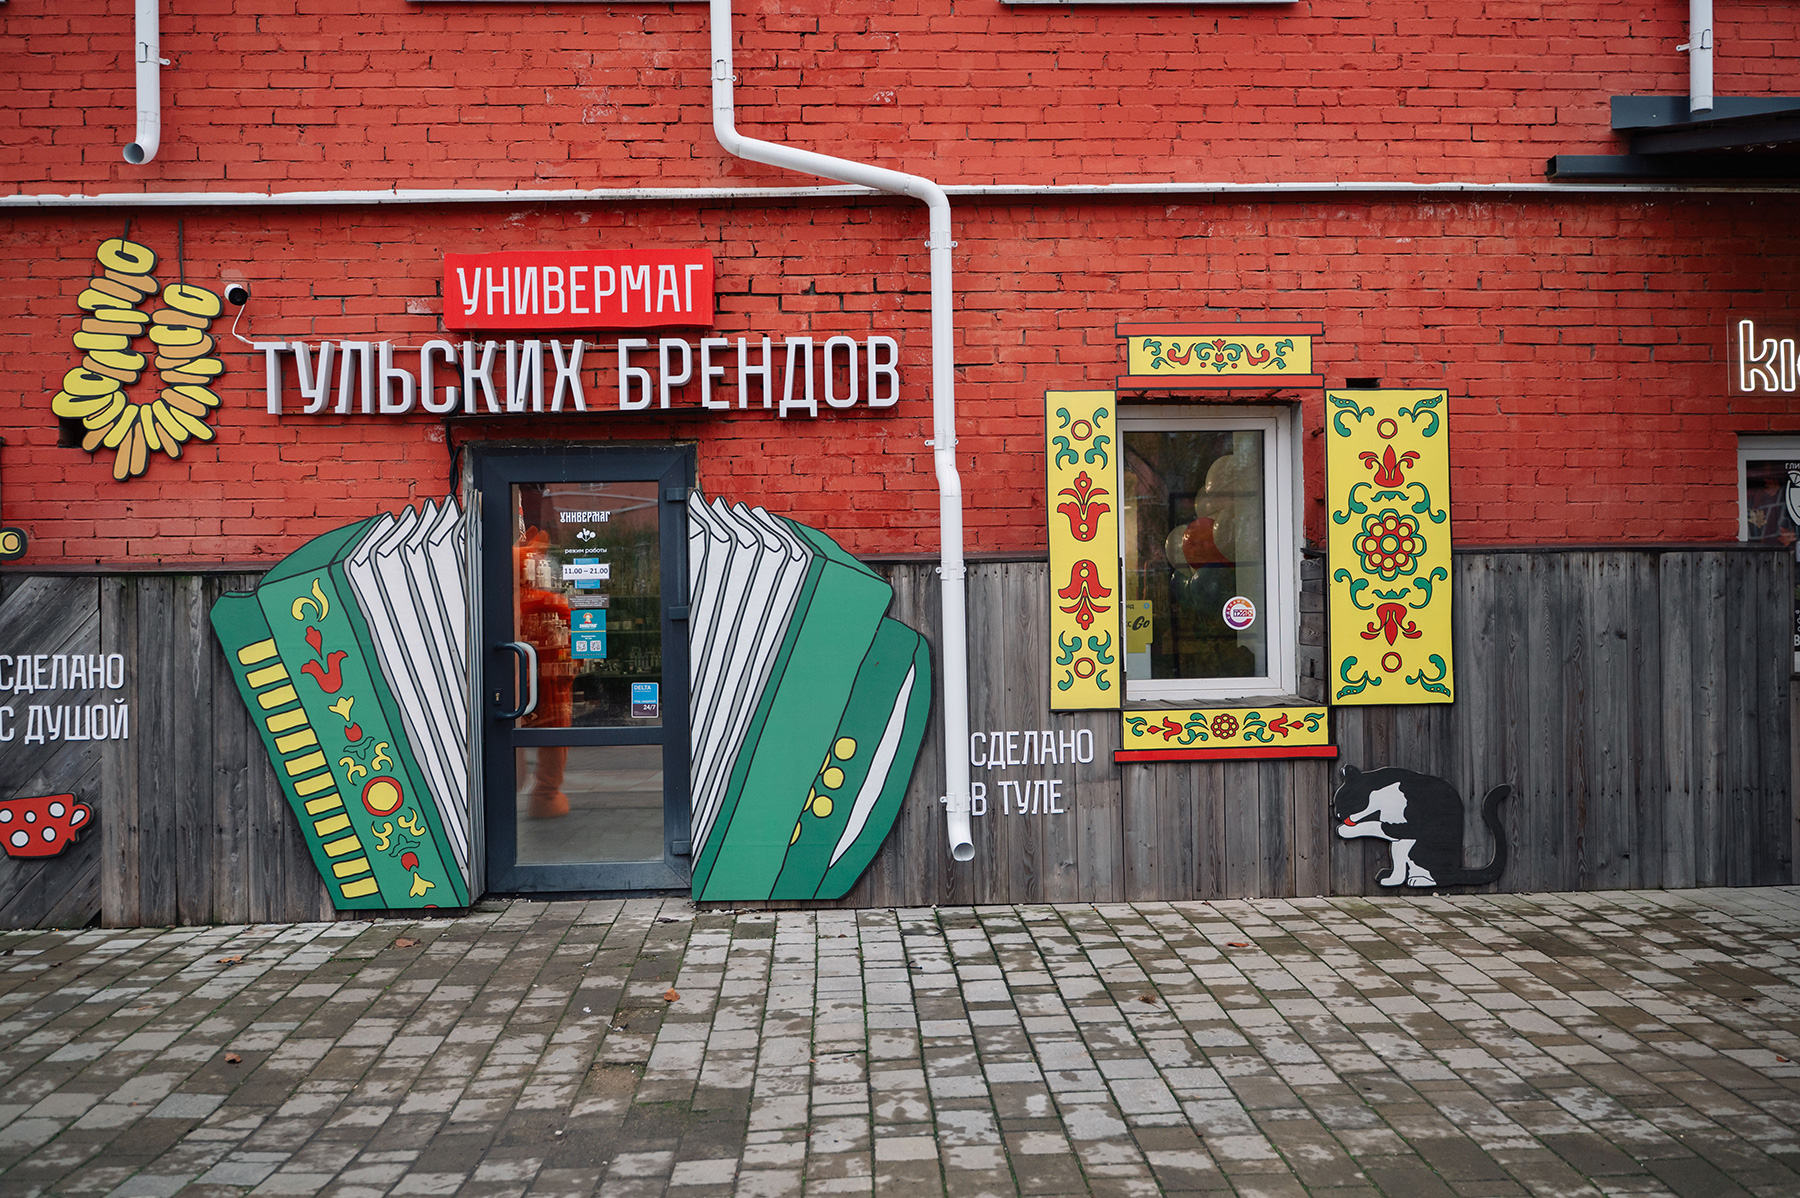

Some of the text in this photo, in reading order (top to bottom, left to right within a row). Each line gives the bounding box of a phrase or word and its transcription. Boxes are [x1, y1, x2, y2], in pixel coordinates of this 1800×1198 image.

[457, 264, 704, 316] УНИВЕРМАГ
[254, 336, 900, 418] ТУЛЬСКИХ БРЕНДОВ
[560, 511, 611, 523] УНИВЕРМАГ
[585, 547, 608, 555] работы
[589, 567, 609, 575] 21.00
[1132, 615, 1150, 631] Go
[0, 653, 125, 695] СДЕЛАНО
[0, 698, 129, 745] С ДУШОЙ
[970, 729, 1094, 770] СДЕЛАНО
[971, 780, 1064, 816] В ТУЛЕ
